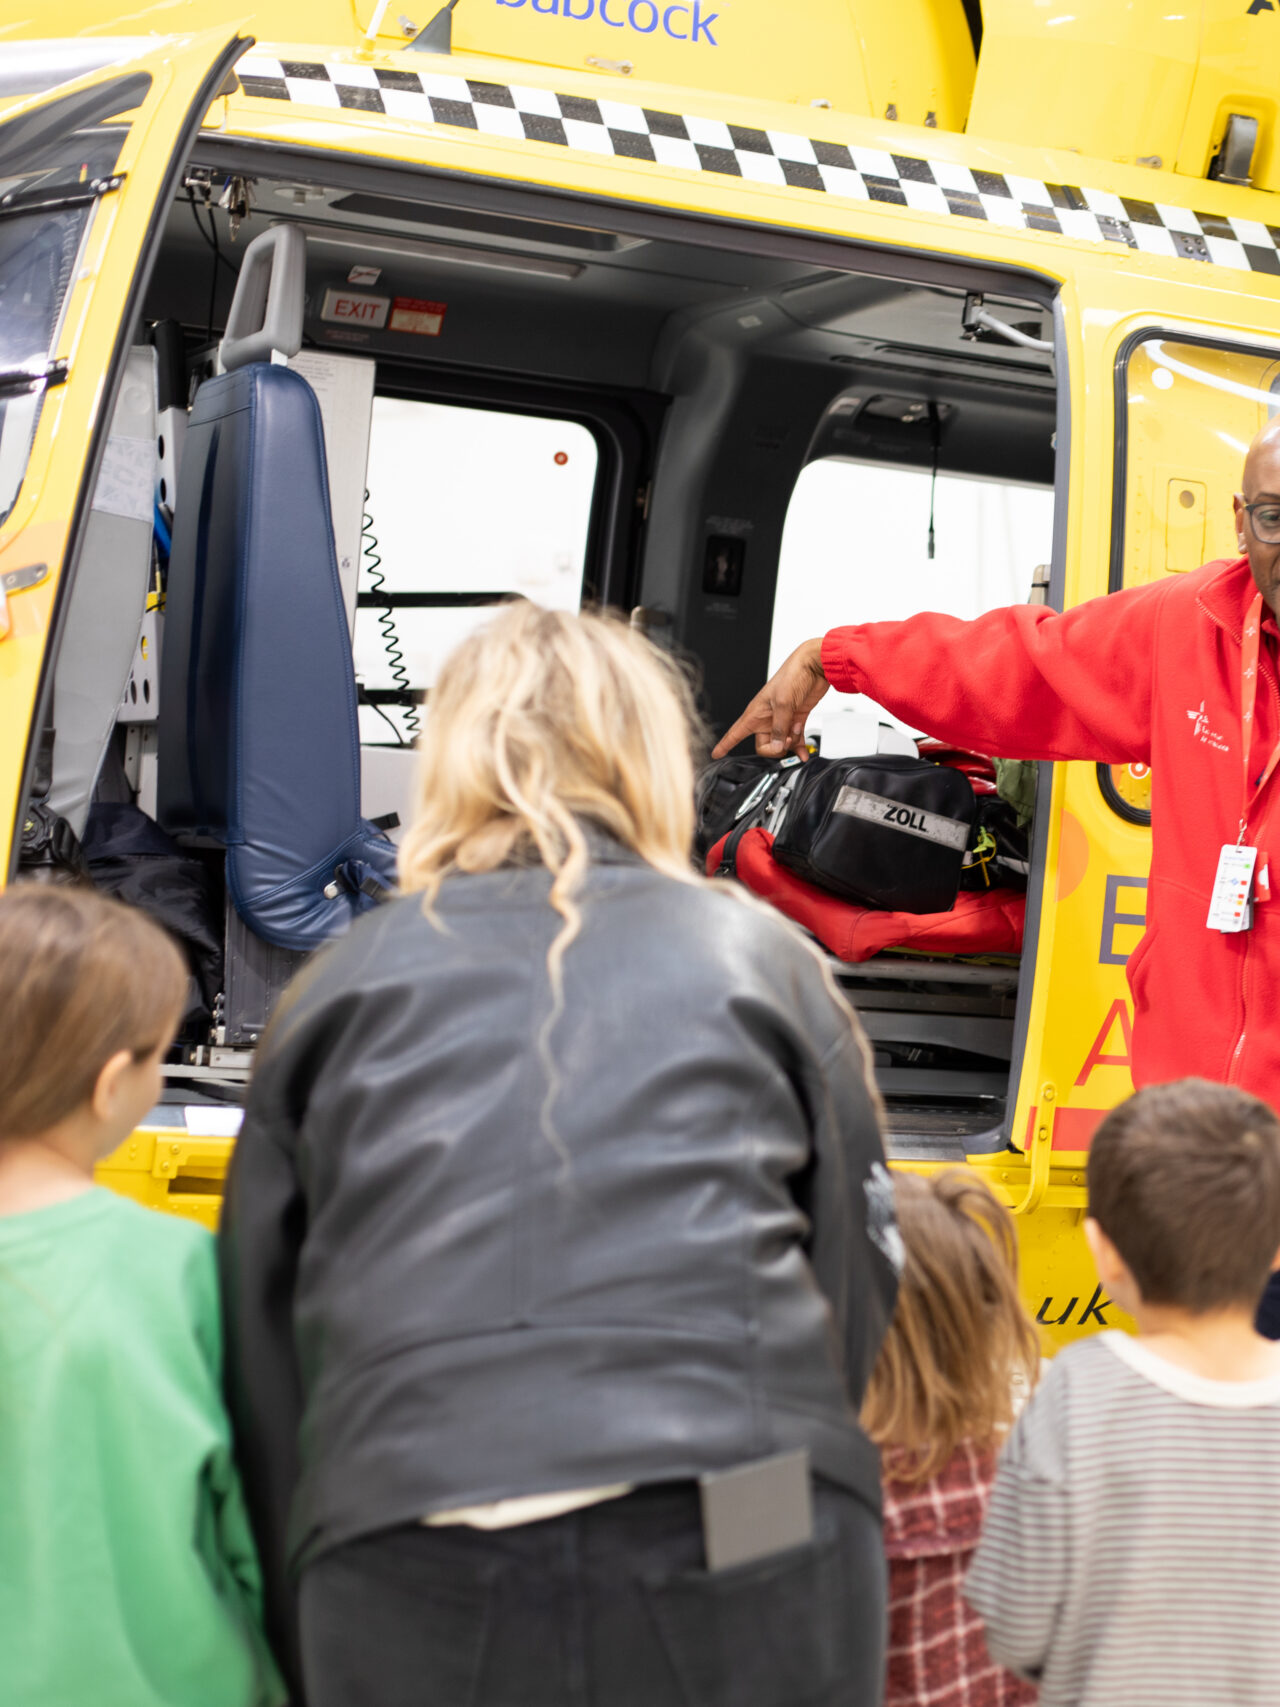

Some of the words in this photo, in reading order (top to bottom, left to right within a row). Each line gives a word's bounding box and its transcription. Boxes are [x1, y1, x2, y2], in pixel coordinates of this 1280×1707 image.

[495, 0, 719, 46] cock
[334, 299, 382, 320] EXIT
[883, 804, 928, 832] ZOLL
